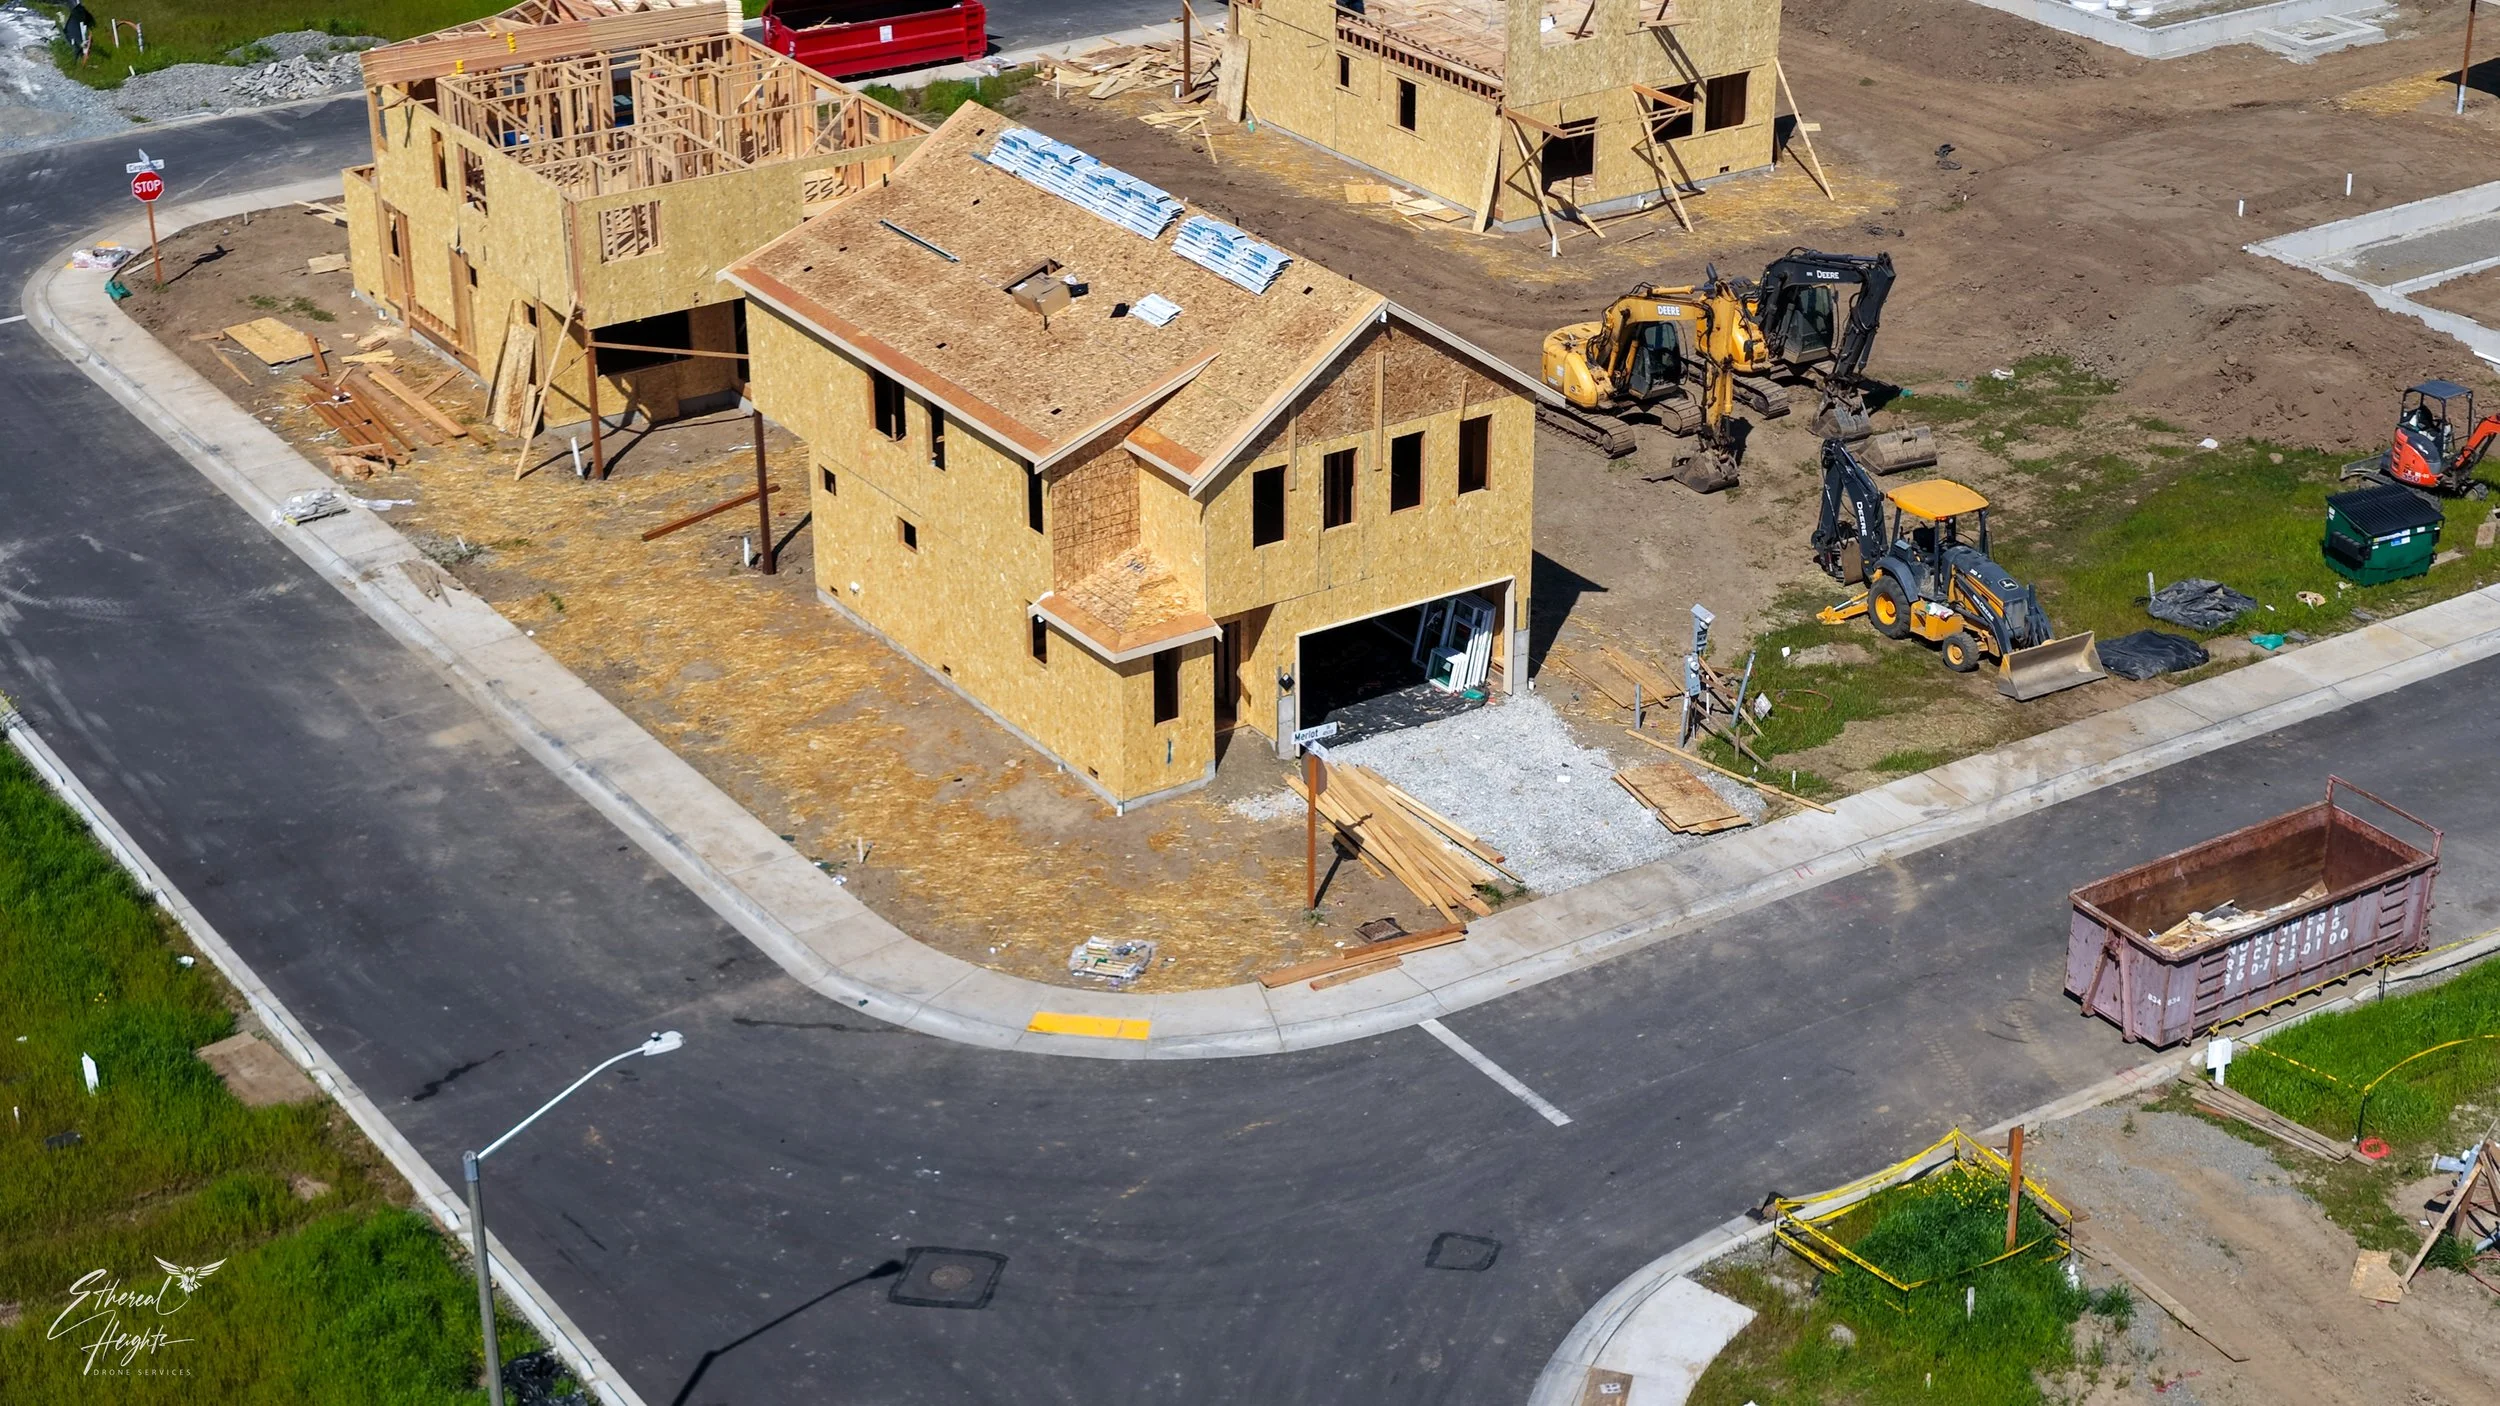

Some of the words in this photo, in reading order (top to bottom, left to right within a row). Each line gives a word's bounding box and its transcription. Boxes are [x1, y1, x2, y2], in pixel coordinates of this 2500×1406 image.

[134, 179, 161, 194] STOP
[1816, 269, 1840, 280] DEERE
[1657, 305, 1681, 316] DEERE
[1856, 501, 1868, 537] DEERE
[1294, 729, 1319, 742] Merlot
[2226, 916, 2341, 971] RECYCLING
